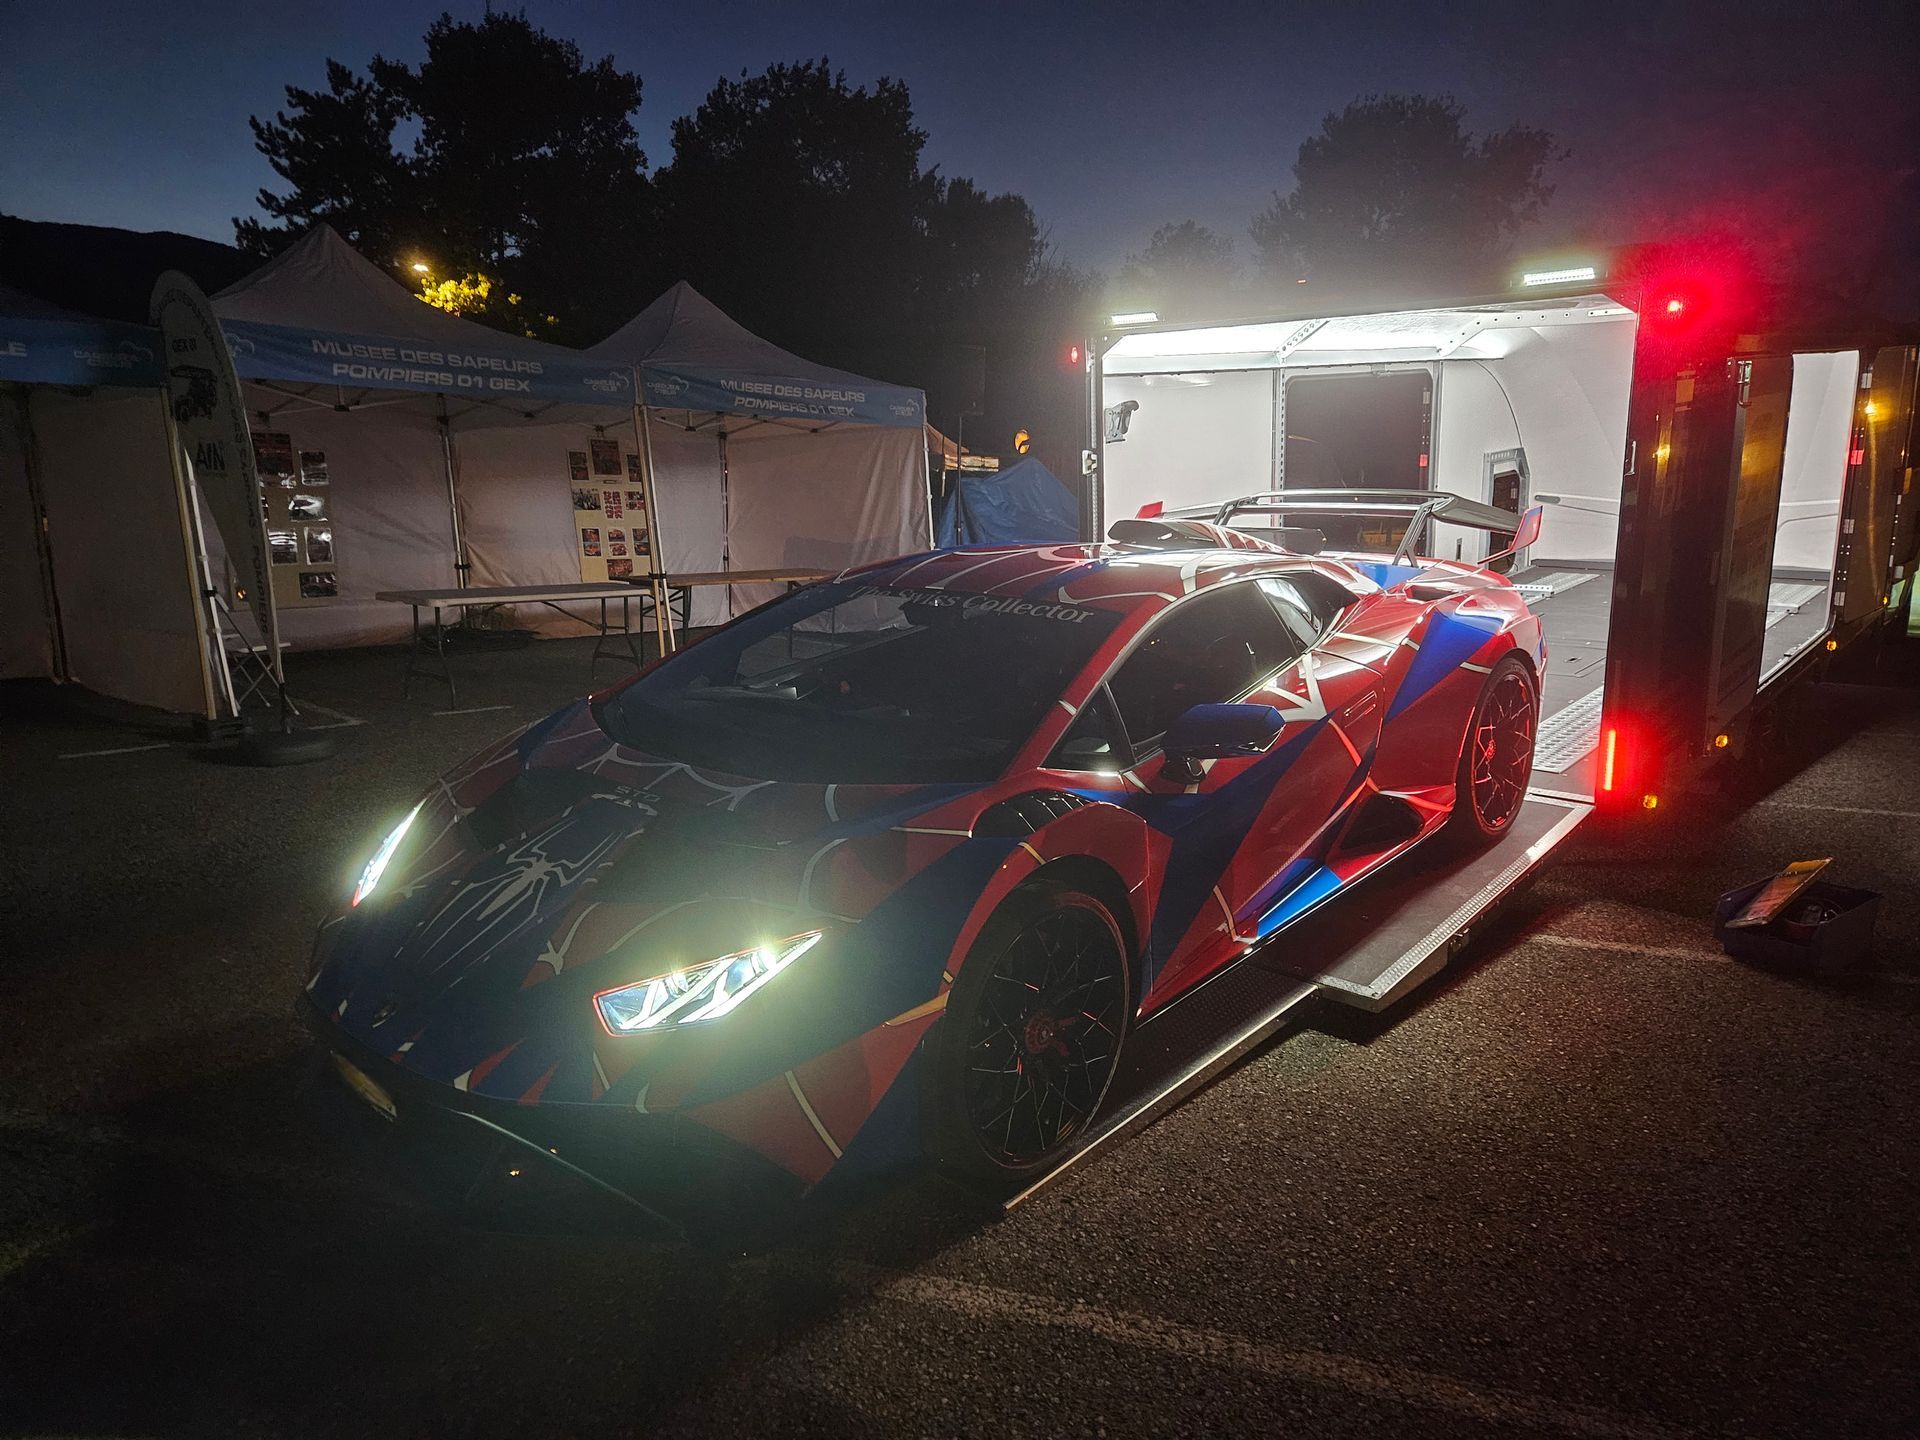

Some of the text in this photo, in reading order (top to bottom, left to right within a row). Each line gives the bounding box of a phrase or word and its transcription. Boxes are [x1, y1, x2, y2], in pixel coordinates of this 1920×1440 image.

[312, 339, 544, 375] MUSEE DES SAPEURS
[333, 363, 532, 393] POMPIERS 01 GEX
[720, 379, 865, 403] MUSEE DES SAPEURS
[734, 396, 855, 417] POMPIERS 01 GEX
[195, 440, 225, 471] AIN
[898, 587, 957, 607] Swiss
[962, 594, 1095, 624] Collector
